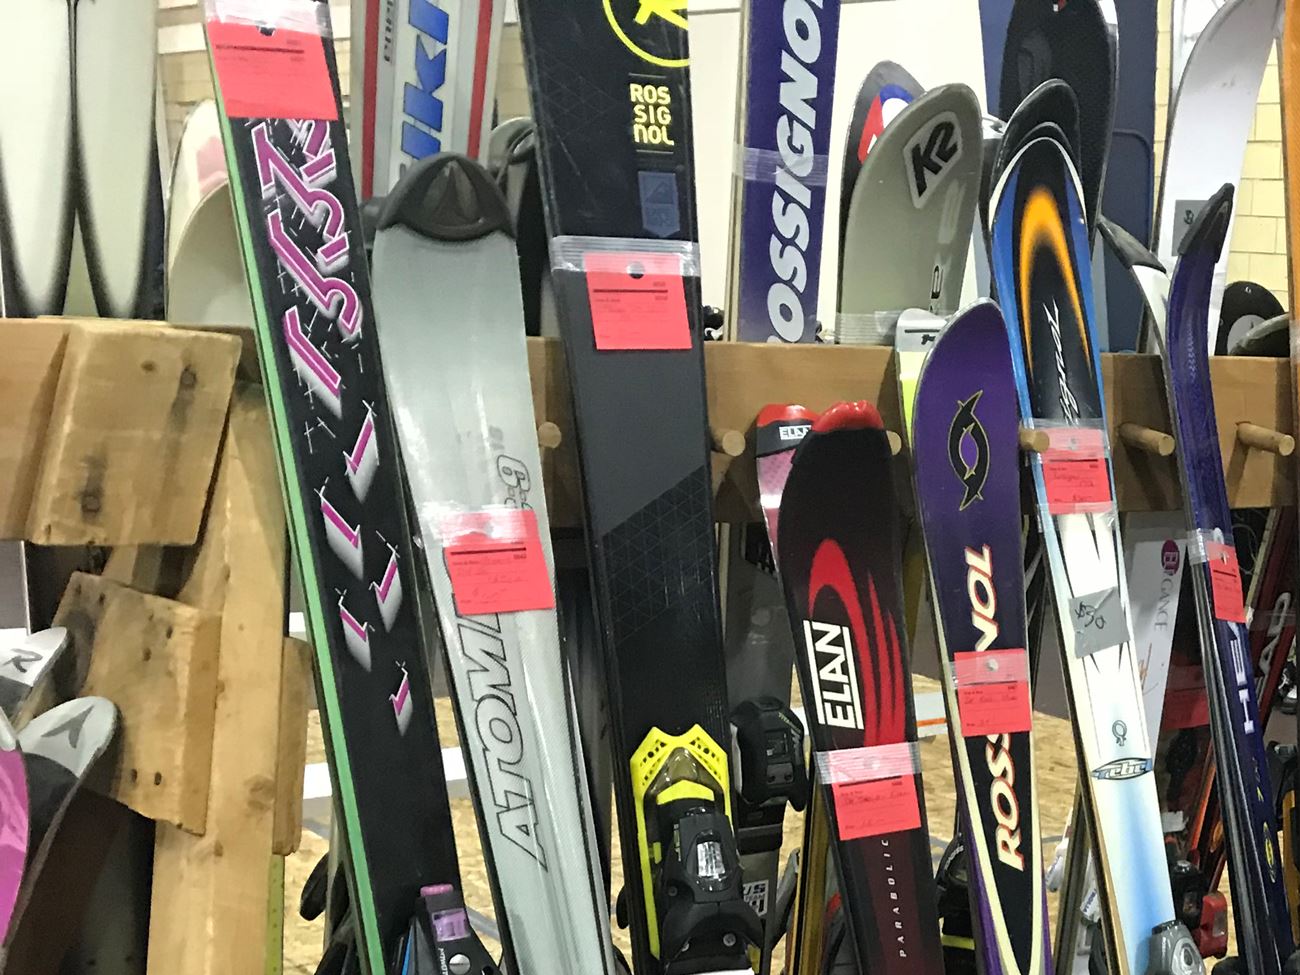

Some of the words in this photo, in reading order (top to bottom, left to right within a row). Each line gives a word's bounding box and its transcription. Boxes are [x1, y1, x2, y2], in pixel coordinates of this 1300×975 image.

[629, 83, 671, 104] ROS
[633, 105, 672, 125] SIG
[767, 0, 832, 343] OSSIGNO
[911, 121, 958, 198] K2
[811, 620, 857, 728] ELAN
[964, 543, 1025, 872] ROSSNOL
[881, 838, 908, 958] PARABOLIC
